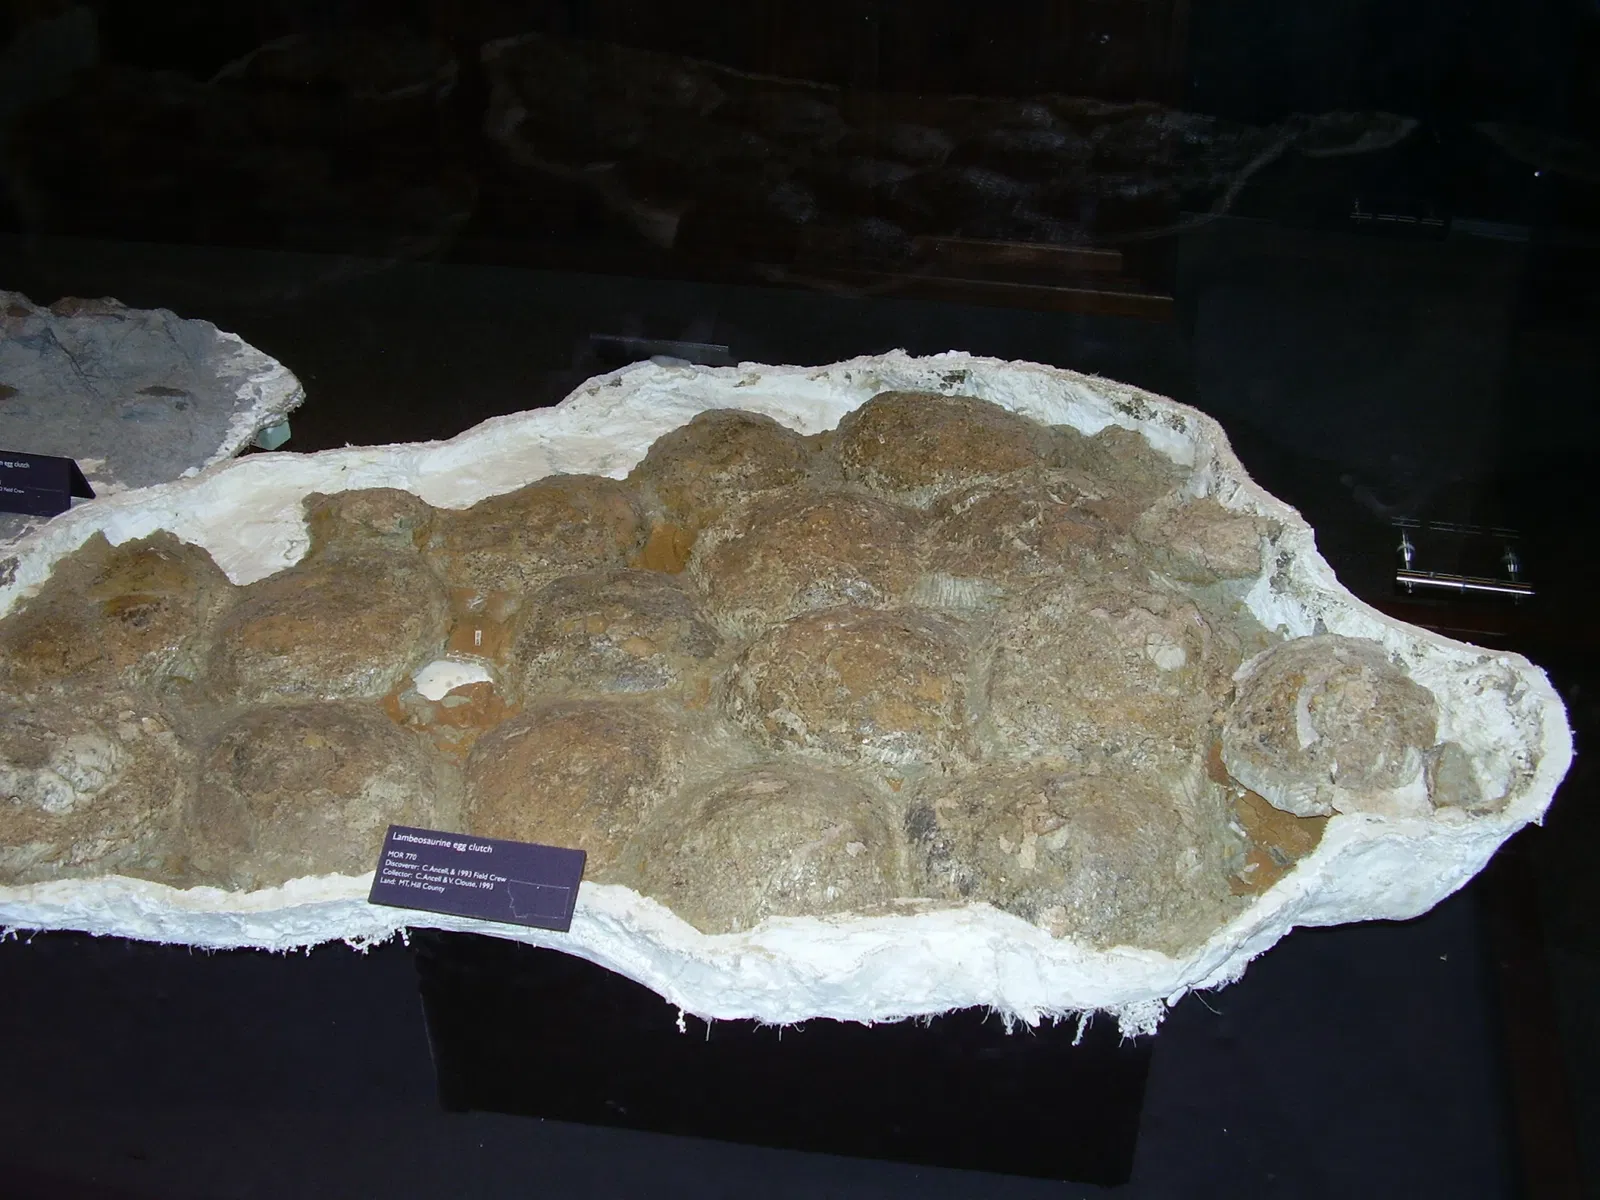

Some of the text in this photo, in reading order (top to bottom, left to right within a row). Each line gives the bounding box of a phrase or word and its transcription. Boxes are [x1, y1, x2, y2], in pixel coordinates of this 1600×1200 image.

[392, 832, 493, 853] Lambeosaurine egg clutch
[383, 868, 413, 878] Collector:
[479, 882, 494, 890] 1993
[385, 859, 420, 870] Discoverer:
[457, 870, 473, 878] 1993
[473, 872, 488, 880] Field
[489, 874, 507, 882] Crew
[380, 877, 396, 885] Land:
[422, 883, 445, 893] County
